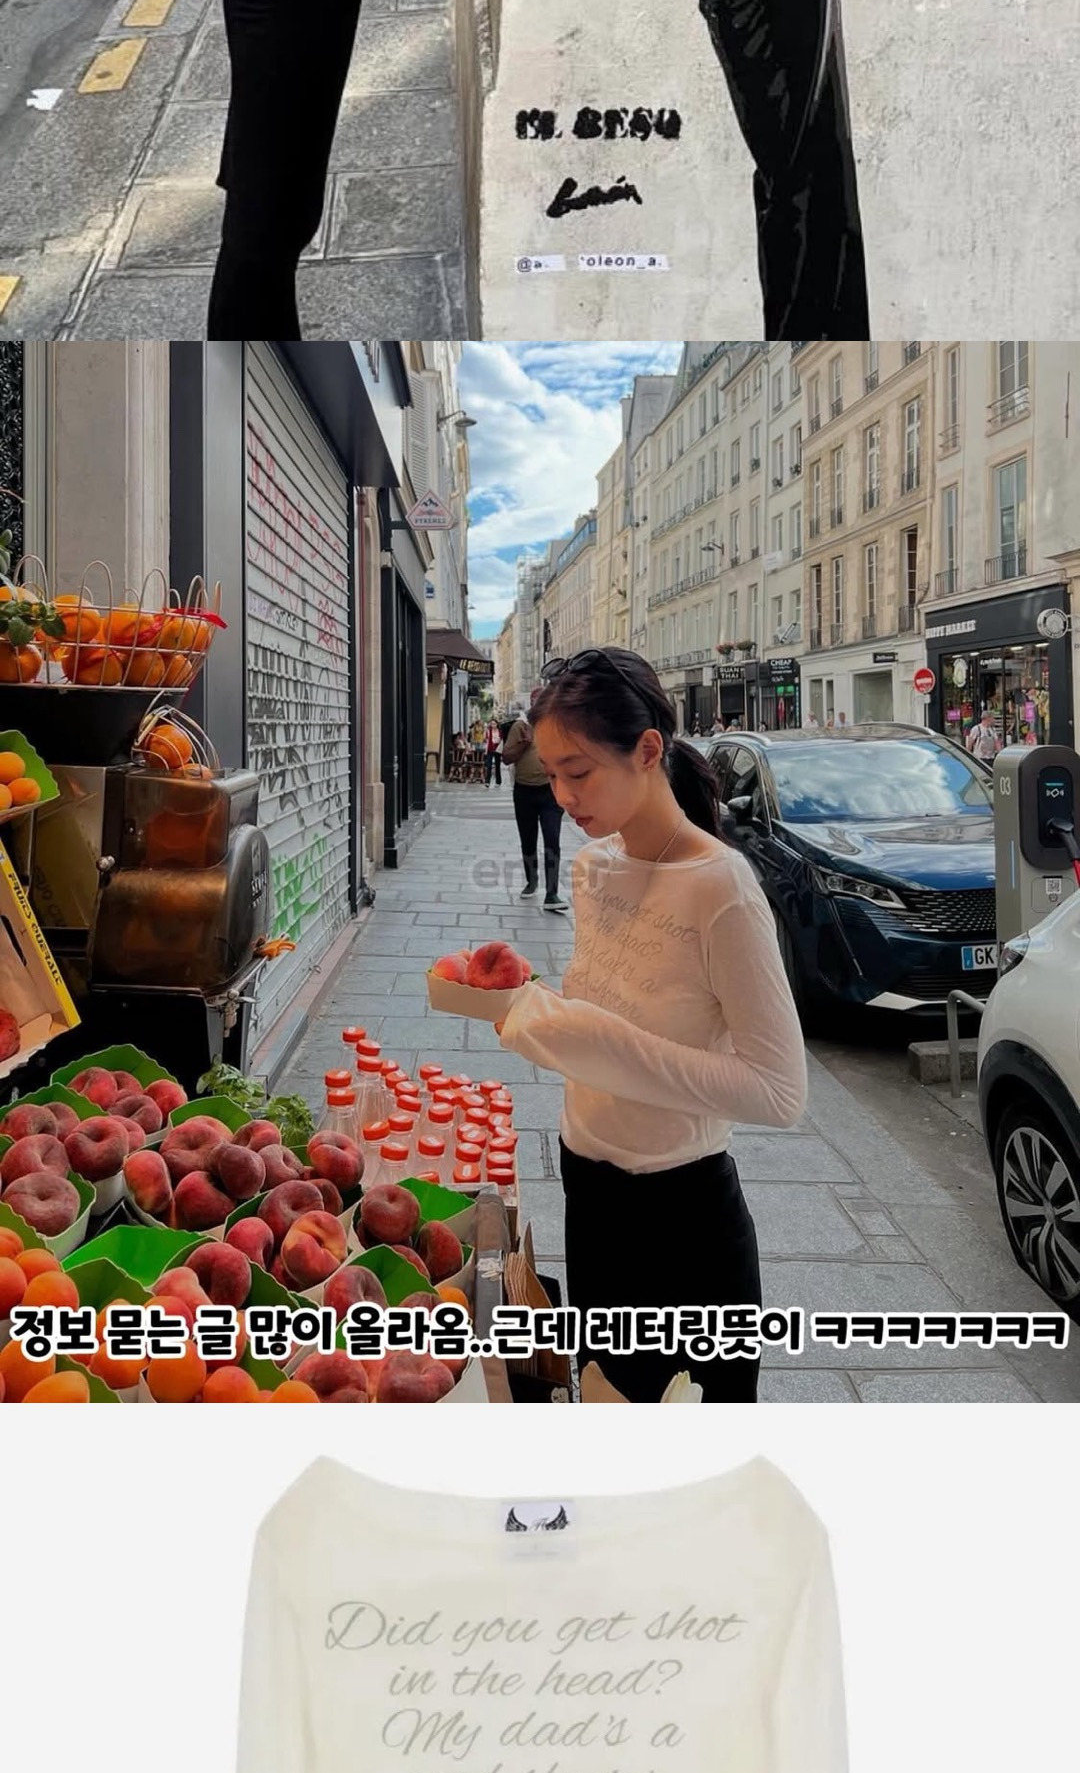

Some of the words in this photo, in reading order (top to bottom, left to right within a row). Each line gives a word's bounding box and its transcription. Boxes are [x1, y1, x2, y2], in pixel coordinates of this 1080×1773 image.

[1000, 777, 1011, 795] 03
[653, 913, 700, 944] shot
[325, 1600, 442, 1651] Did
[452, 1616, 543, 1657] you
[550, 1611, 638, 1654] get
[644, 1604, 748, 1643] shot
[388, 1665, 436, 1696] in
[452, 1660, 525, 1696] the
[535, 1659, 683, 1696] head?
[381, 1708, 483, 1760] My
[499, 1711, 631, 1748] dad's
[650, 1721, 687, 1748] a
